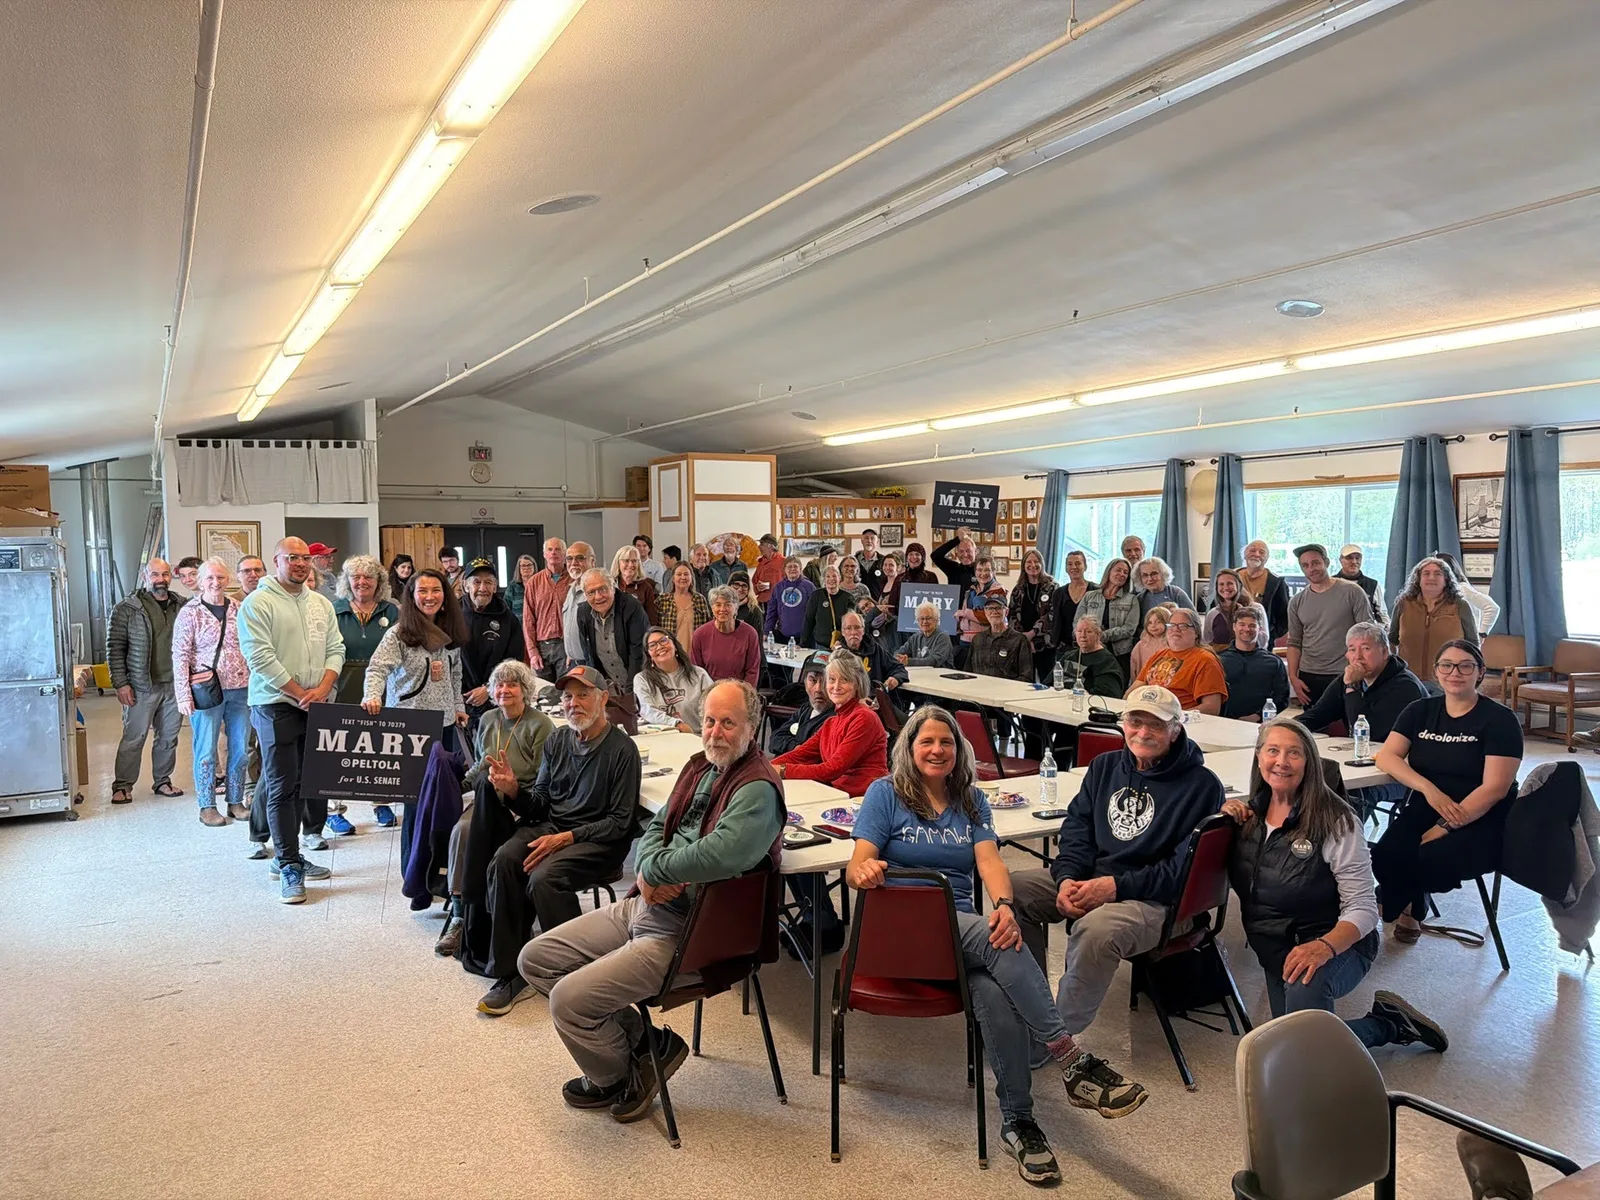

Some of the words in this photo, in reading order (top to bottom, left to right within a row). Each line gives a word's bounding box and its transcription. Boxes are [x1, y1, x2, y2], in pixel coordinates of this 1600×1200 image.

[939, 494, 993, 510] MARY
[950, 508, 979, 516] @PELTOLA
[342, 718, 355, 726] TEXT
[357, 719, 378, 727] "FISH"
[387, 721, 406, 729] 70379
[316, 728, 431, 757] MARY
[341, 757, 401, 770] @PELTOLA
[338, 775, 355, 784] for
[356, 775, 372, 784] U.S.
[373, 776, 401, 786] SENATE
